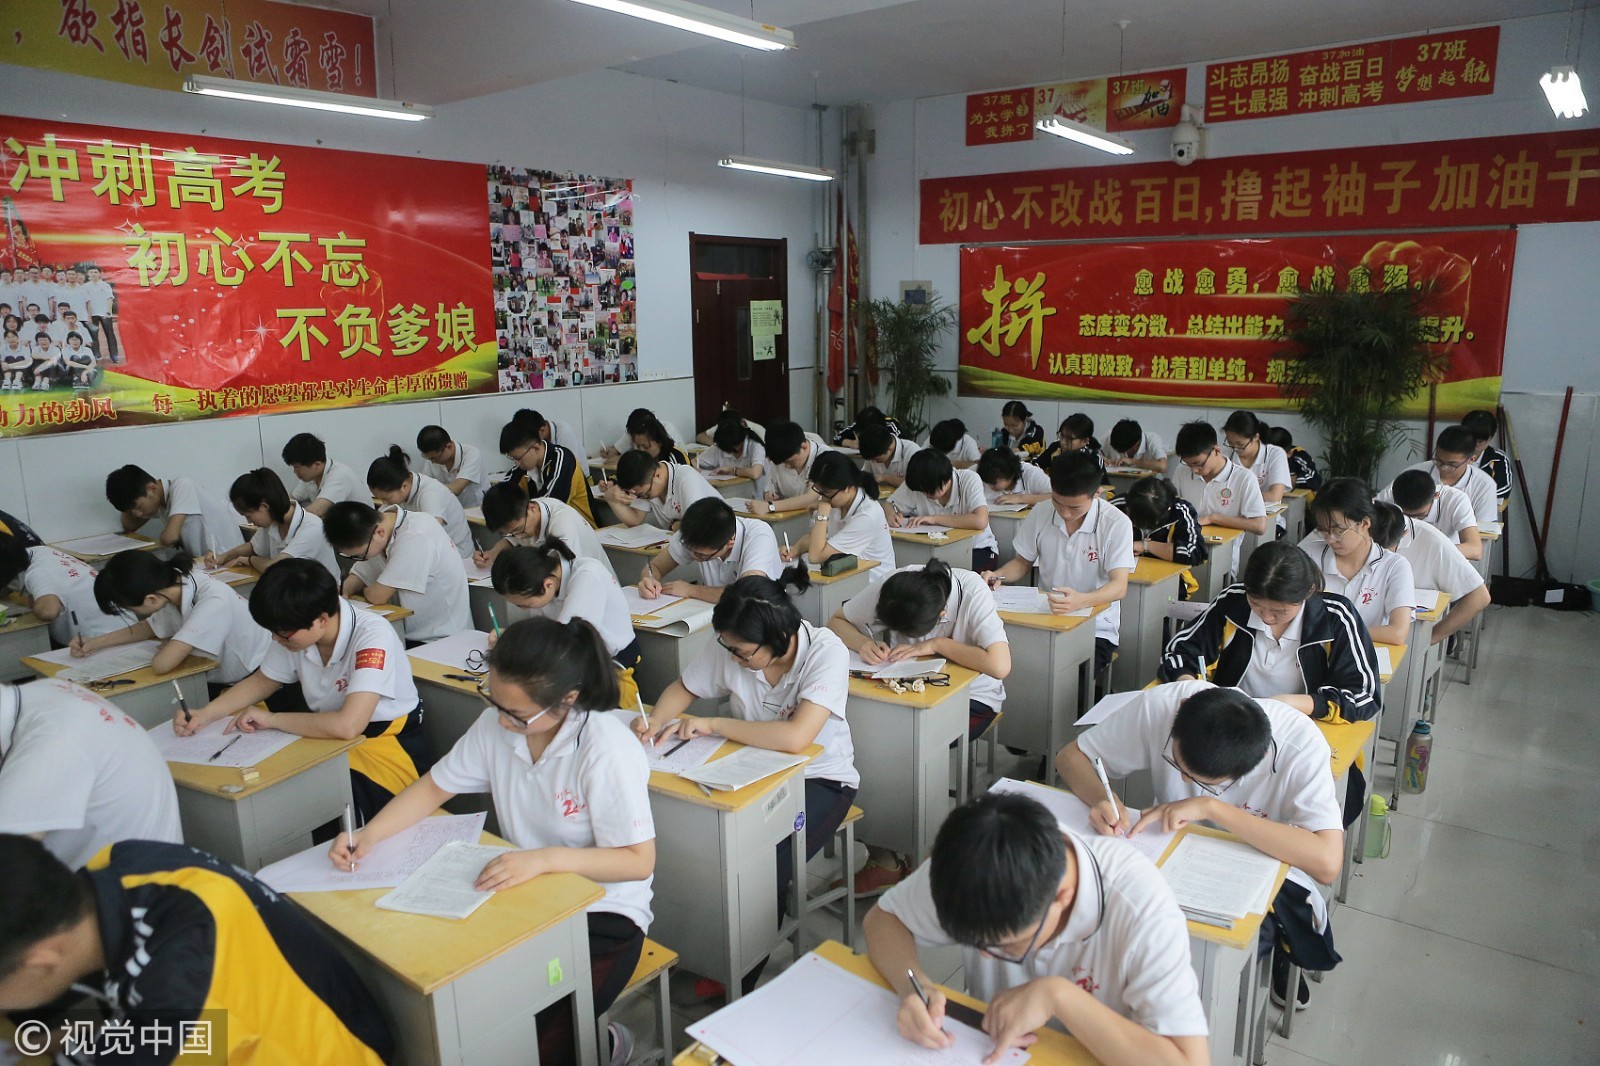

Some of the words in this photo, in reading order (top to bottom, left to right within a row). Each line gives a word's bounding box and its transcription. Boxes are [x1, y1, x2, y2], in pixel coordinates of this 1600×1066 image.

[1416, 39, 1467, 63] 37班
[1112, 79, 1146, 95] 37班
[1208, 59, 1290, 91] 斗志昂扬
[1299, 56, 1384, 87] 奋战百日
[1394, 56, 1491, 93] 梦想起航
[982, 94, 1013, 106] 37班
[1038, 87, 1055, 105] 37
[1208, 87, 1289, 117] 三七最强
[1297, 80, 1384, 110] 冲刺高考
[969, 109, 1014, 125] 为大学
[984, 123, 1029, 139] 我拼了
[4, 133, 287, 214] 冲刺高考
[126, 222, 371, 289] 初心不忘
[276, 302, 479, 362] 不负爹娘
[966, 264, 1057, 371] 拼
